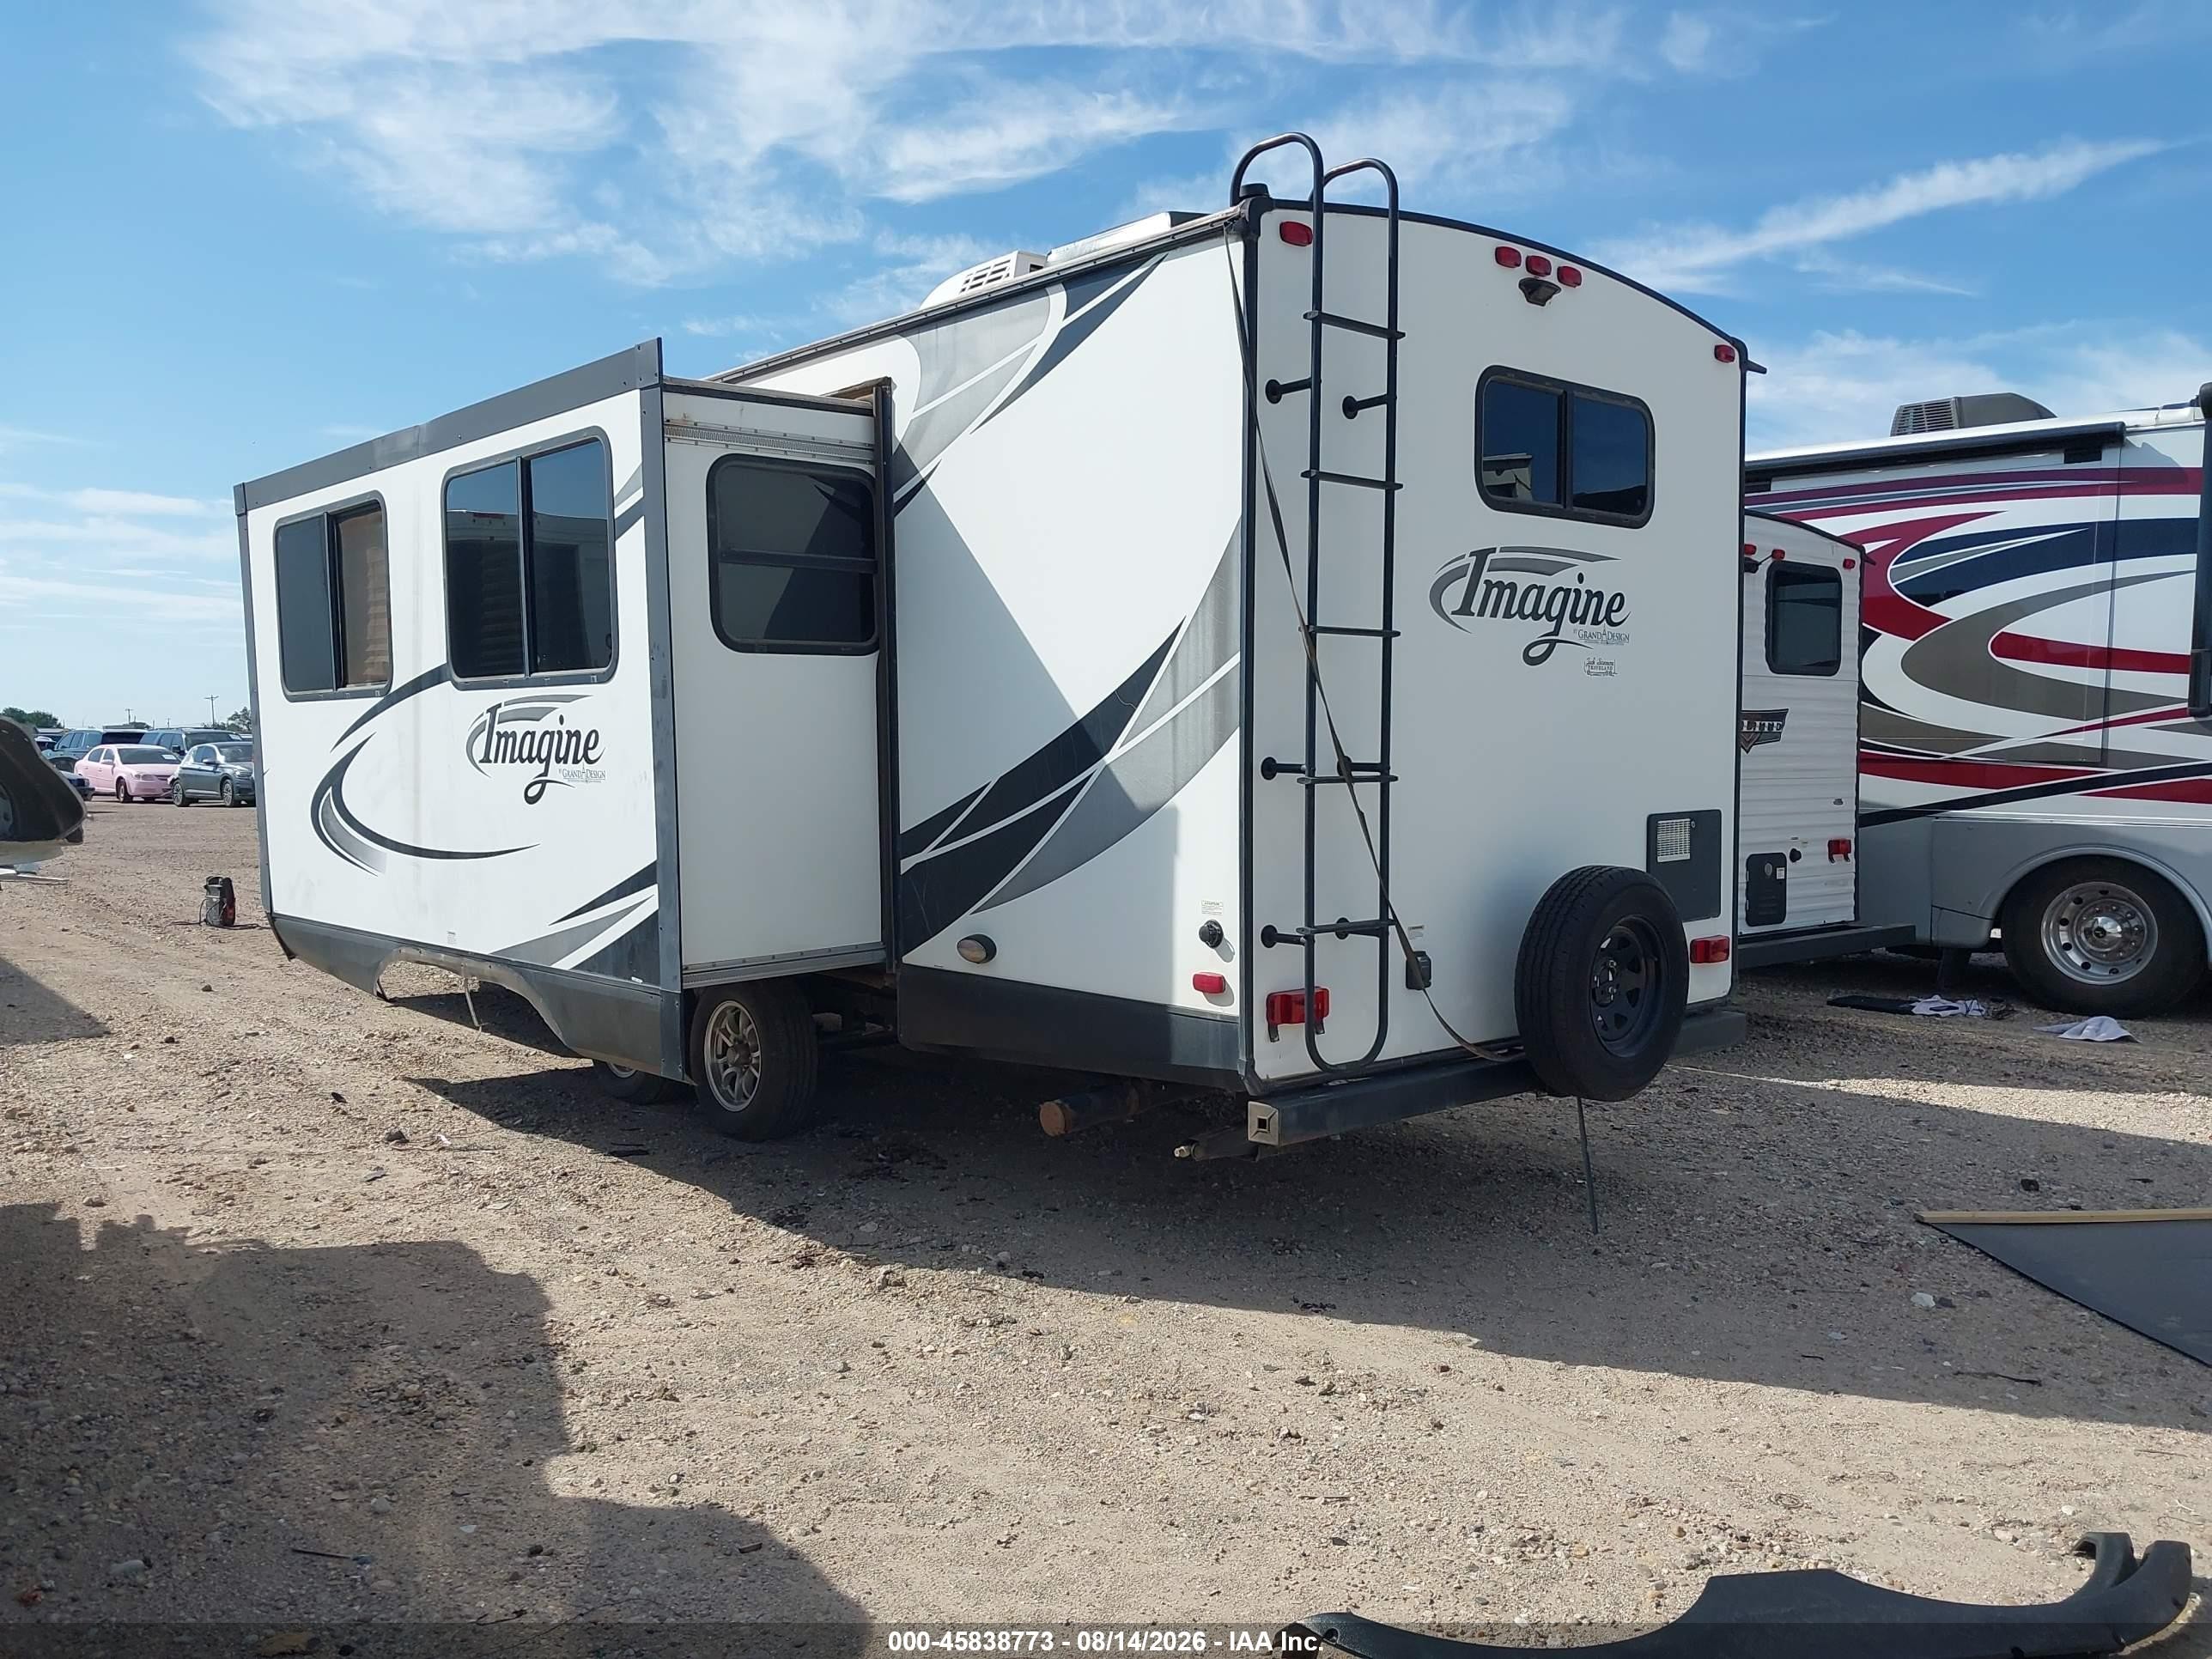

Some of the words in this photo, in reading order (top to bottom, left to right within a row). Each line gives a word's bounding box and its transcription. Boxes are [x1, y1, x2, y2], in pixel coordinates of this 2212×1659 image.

[1450, 547, 1632, 666] Imagine
[1577, 629, 1601, 640] GRAND
[478, 702, 606, 805] Imagine
[1741, 720, 1783, 732] LITE
